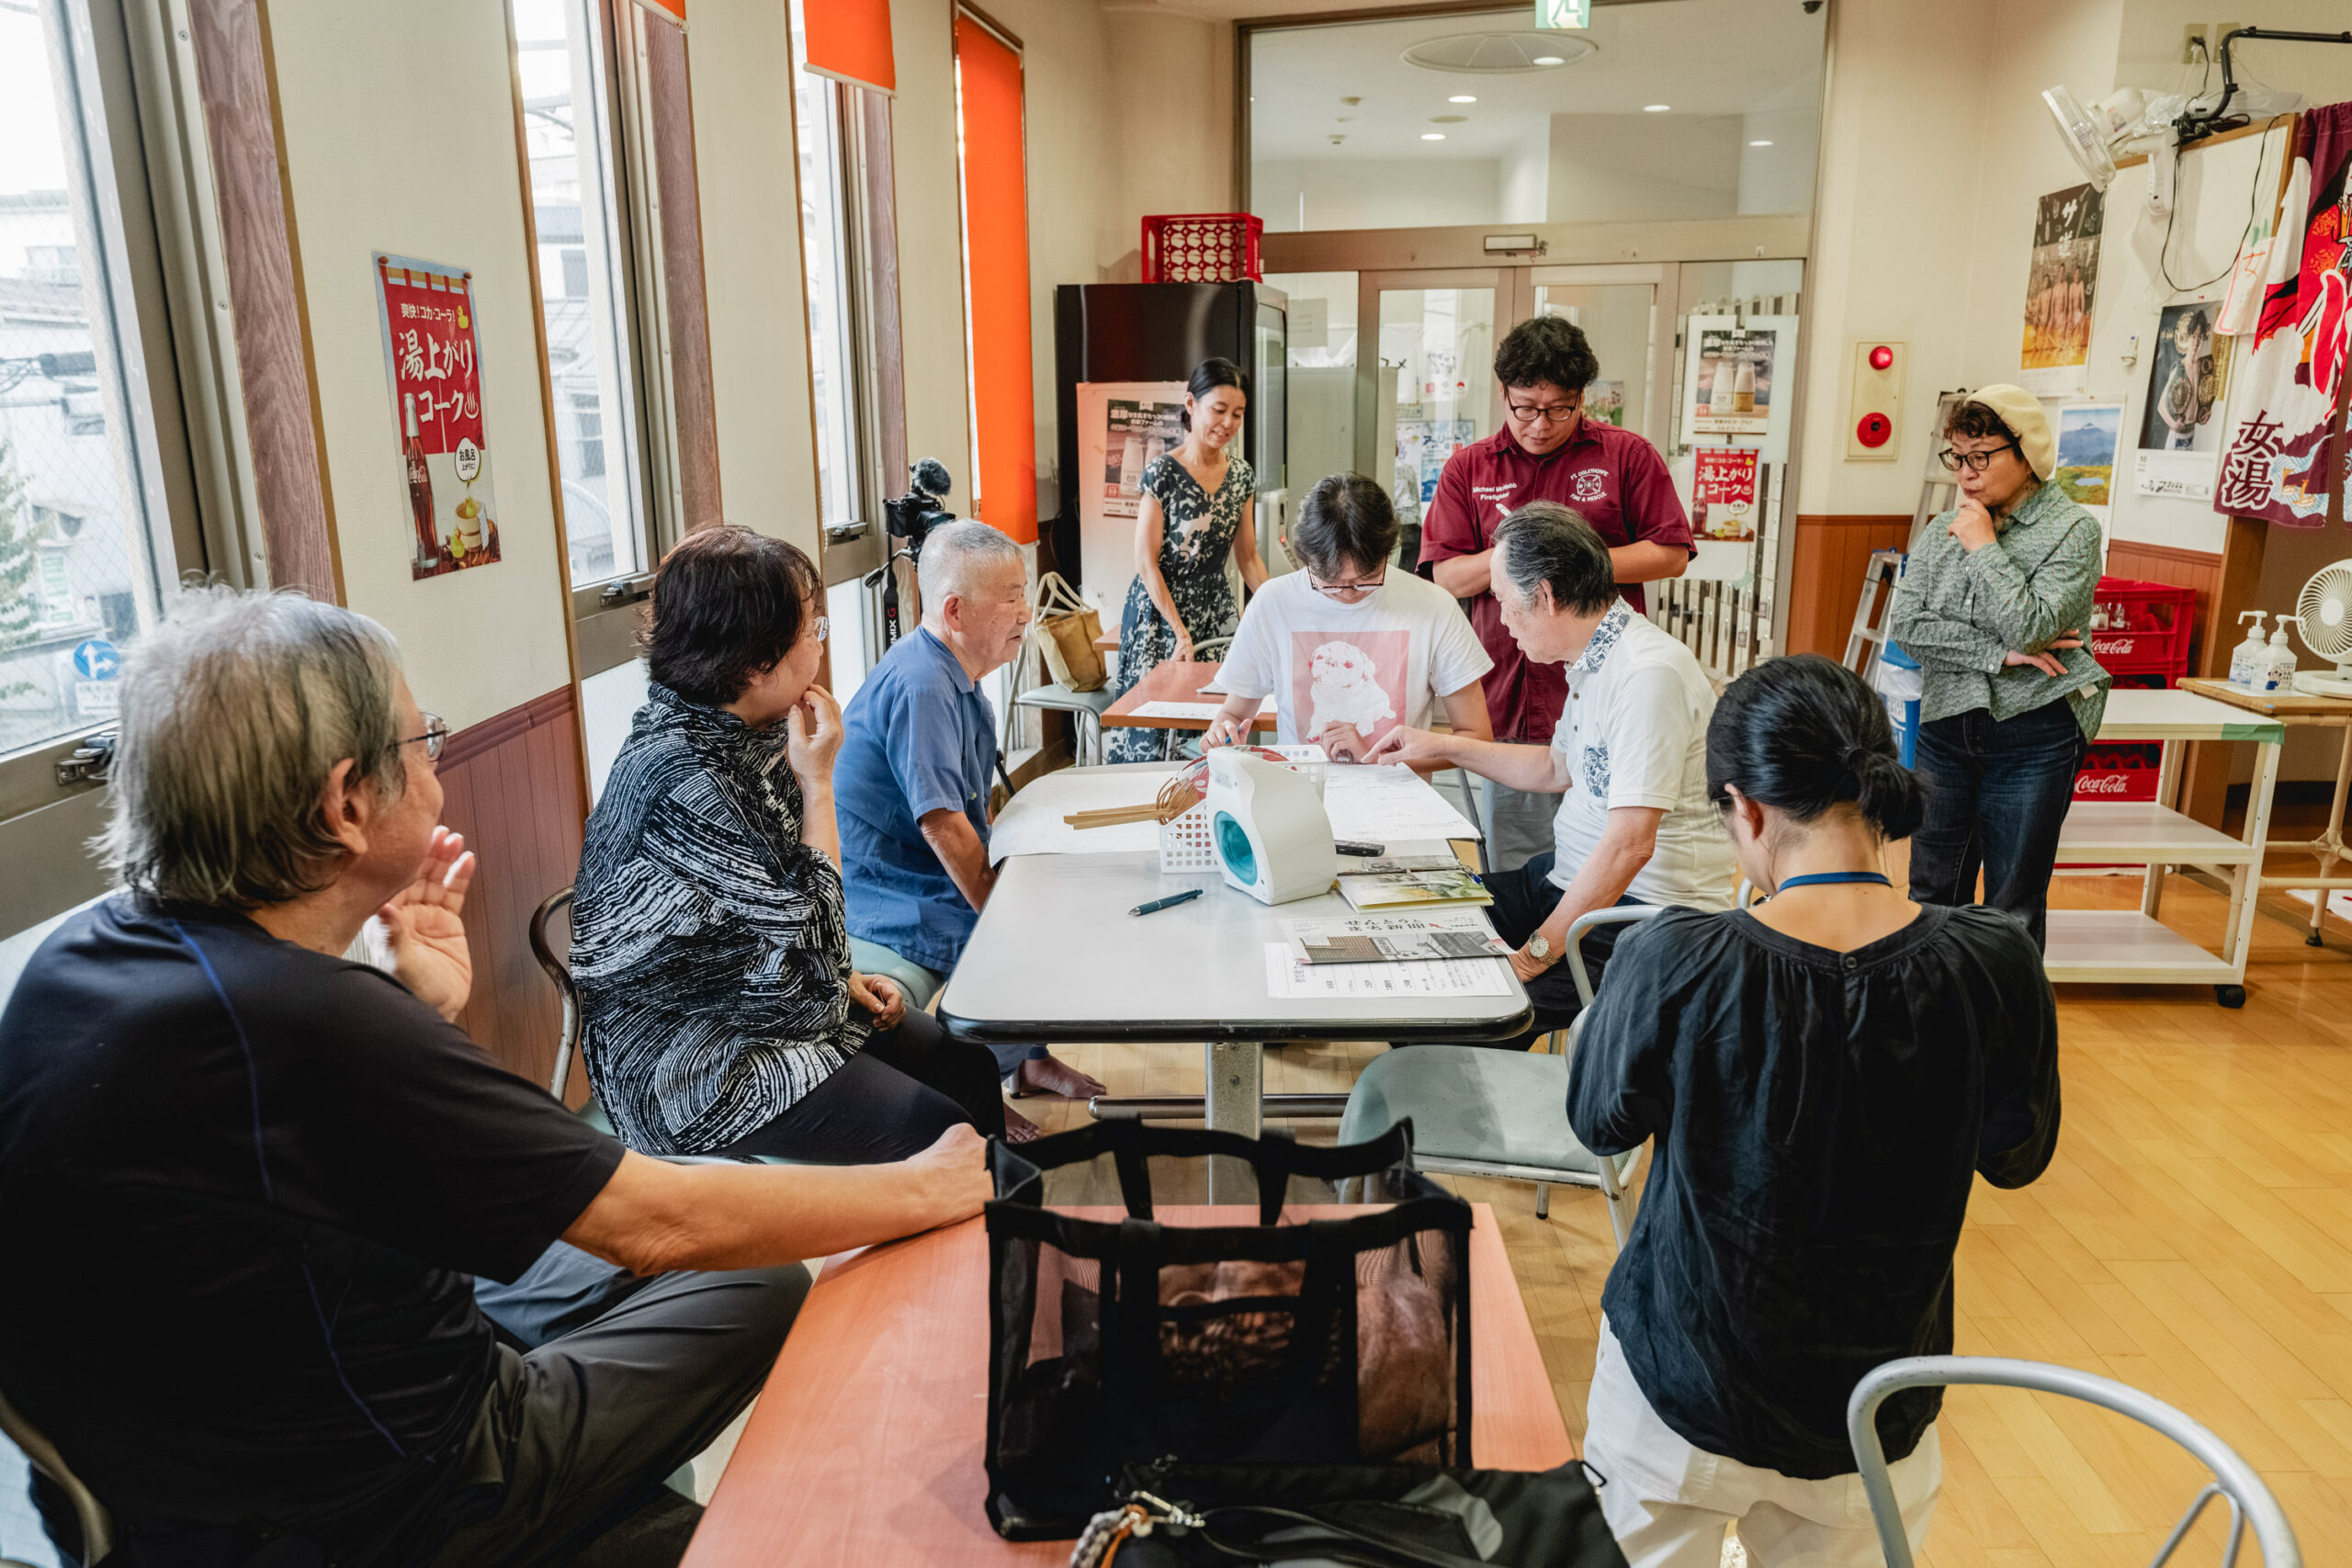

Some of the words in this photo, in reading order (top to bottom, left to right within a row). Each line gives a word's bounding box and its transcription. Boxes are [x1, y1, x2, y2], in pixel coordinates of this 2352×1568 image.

[399, 328, 473, 382] 湯上がり
[418, 389, 465, 423] コーク
[2225, 410, 2283, 506] 女湯
[1698, 466, 1752, 482] 湯上がり
[1480, 491, 1510, 502] Firefighter
[1570, 493, 1581, 502] FIRE
[1587, 491, 1608, 502] RESCUE
[1708, 483, 1742, 495] コーク
[888, 608, 896, 618] G
[888, 619, 898, 645] MIX
